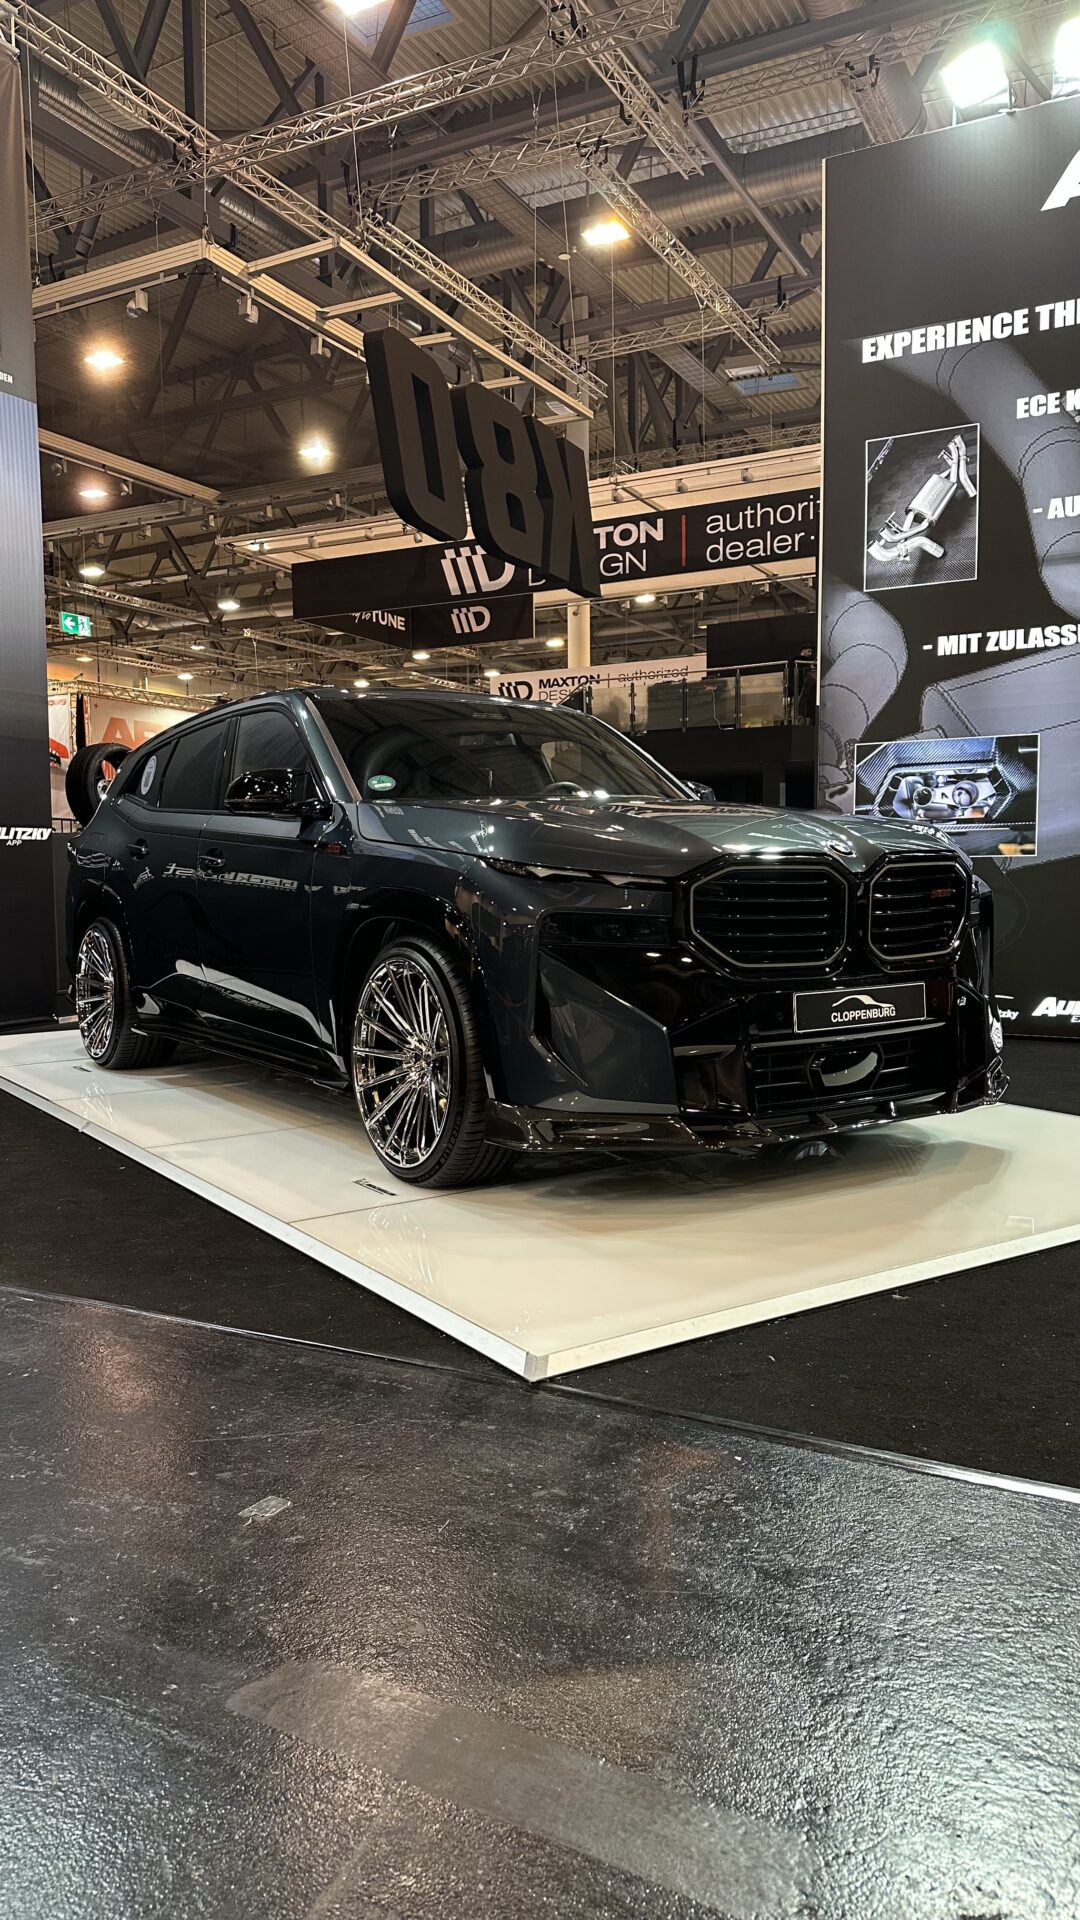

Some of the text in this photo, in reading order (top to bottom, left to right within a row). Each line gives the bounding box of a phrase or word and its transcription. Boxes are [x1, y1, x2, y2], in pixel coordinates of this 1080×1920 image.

[862, 298, 1080, 363] EXPERIENCE TH
[1016, 391, 1060, 419] ECE
[593, 518, 663, 549] TON
[705, 530, 805, 564] dealer
[937, 632, 982, 657] MIT
[985, 624, 1080, 652] ZULASS
[539, 674, 600, 689] MAXTON
[539, 689, 571, 701] DES
[0, 827, 52, 840] LITZKY
[831, 1006, 896, 1022] CLOPPENBURG
